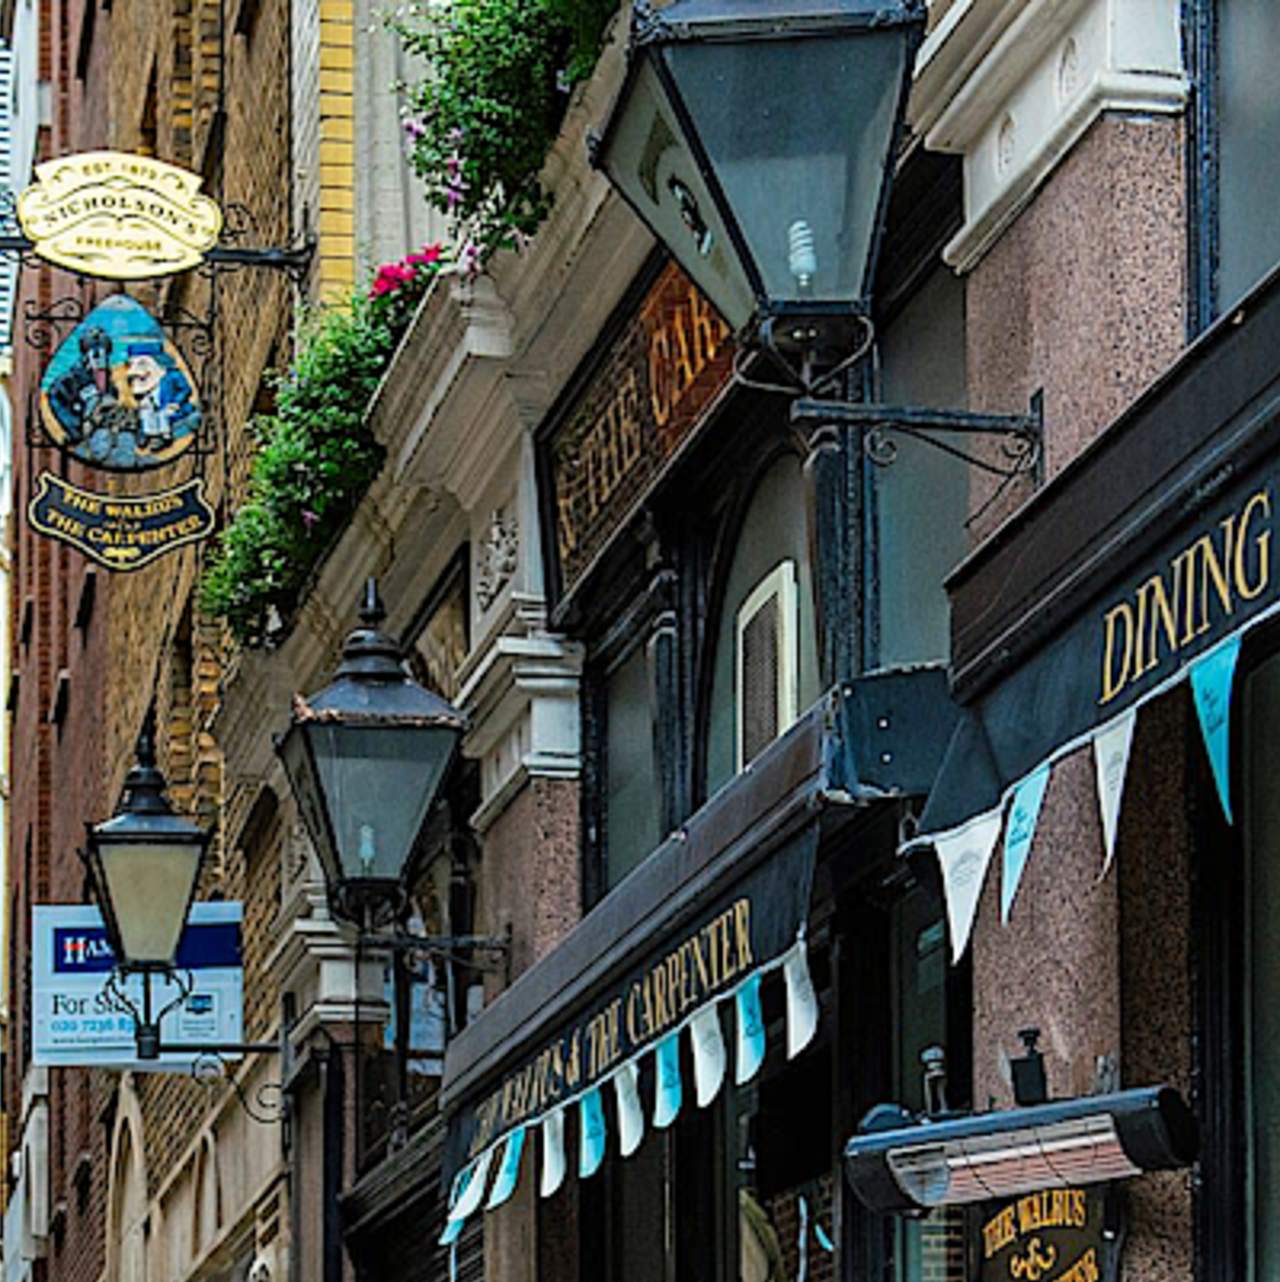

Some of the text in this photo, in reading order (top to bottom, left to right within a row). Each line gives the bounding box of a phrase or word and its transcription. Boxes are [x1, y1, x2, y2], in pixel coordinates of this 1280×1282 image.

[46, 507, 205, 545] THE CARPENTER
[63, 488, 184, 518] THE WALRUS
[1098, 488, 1271, 705] DINING
[52, 994, 89, 1015] For
[585, 997, 623, 1080] THE
[626, 898, 754, 1046] CARPENTER
[982, 1189, 1086, 1259] THE WALRUS
